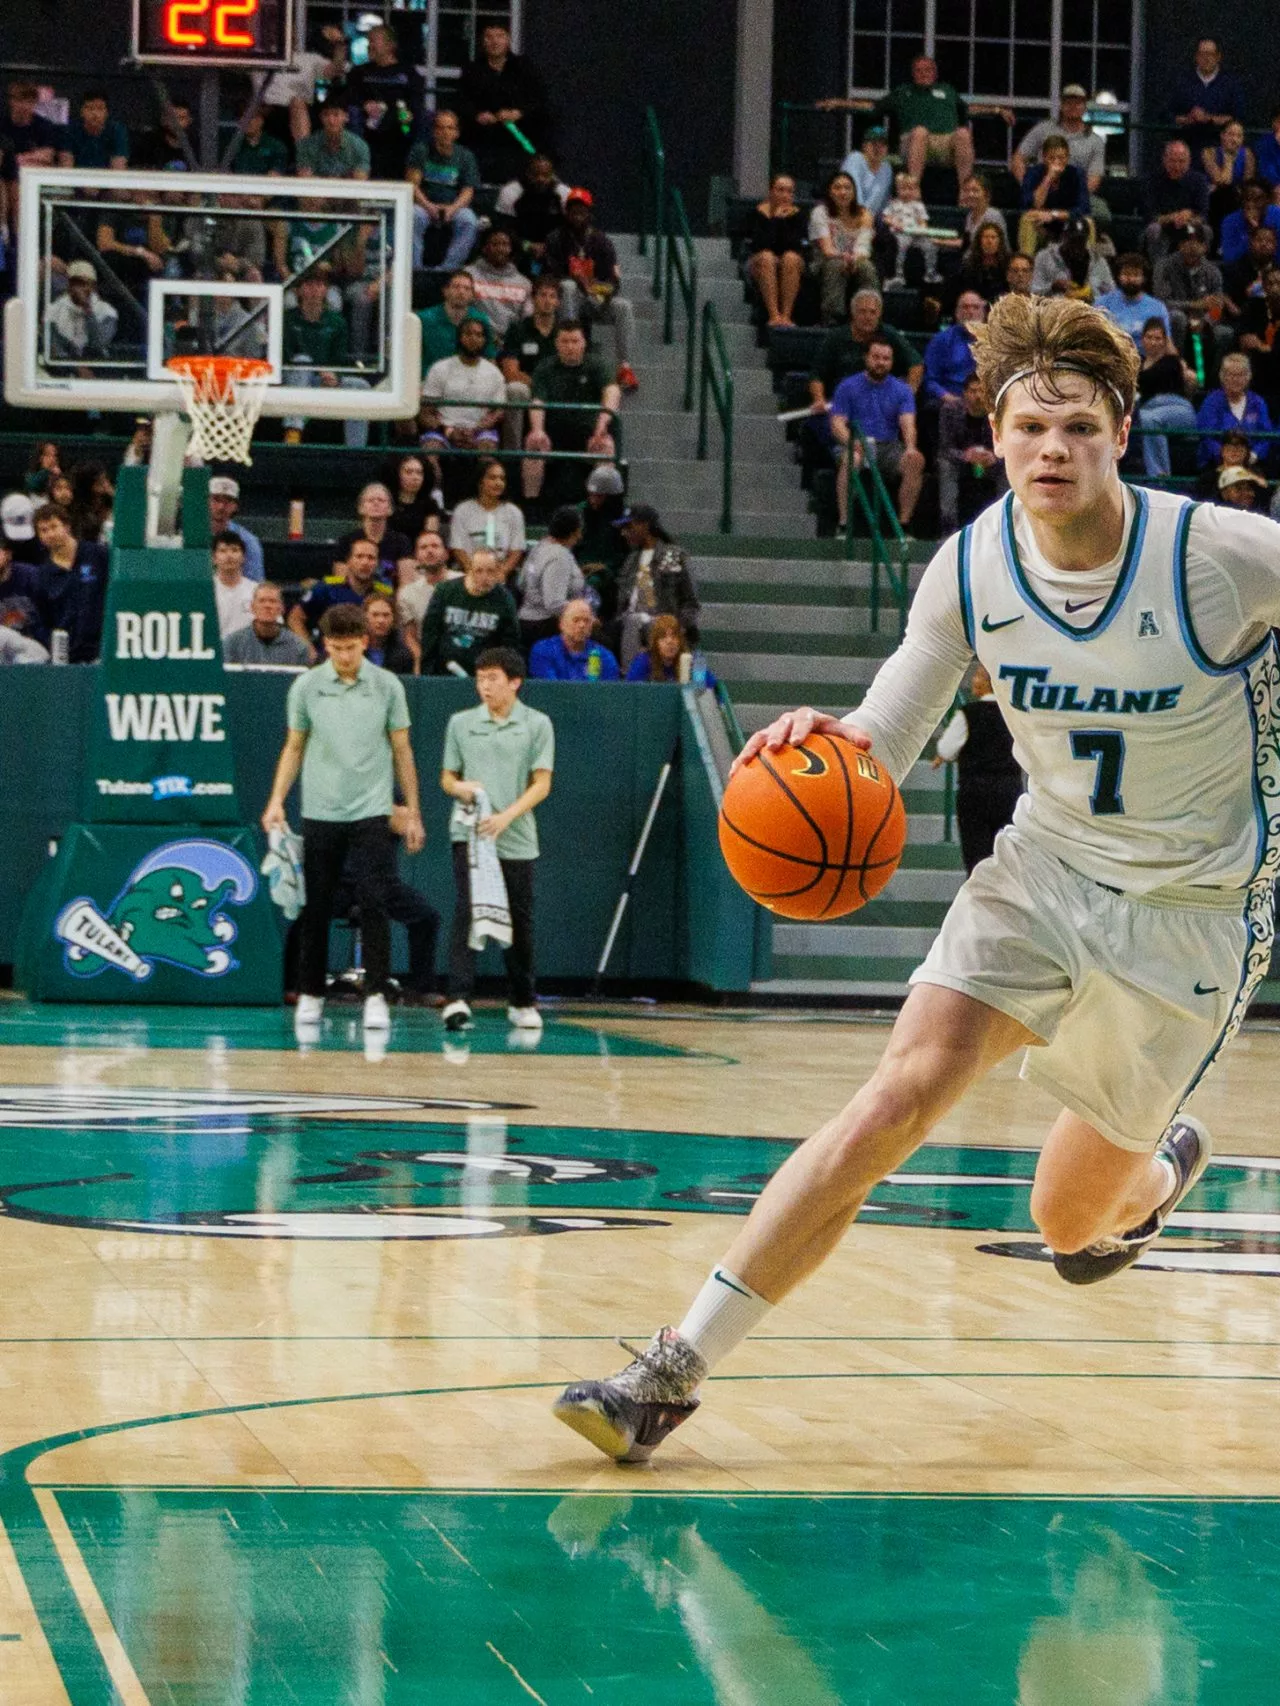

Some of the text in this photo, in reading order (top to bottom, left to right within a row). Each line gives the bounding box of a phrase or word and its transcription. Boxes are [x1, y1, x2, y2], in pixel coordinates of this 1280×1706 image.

[115, 611, 216, 660] ROLL
[998, 664, 1184, 713] TULANE
[105, 693, 226, 742] WAVE
[1069, 730, 1126, 816] 7
